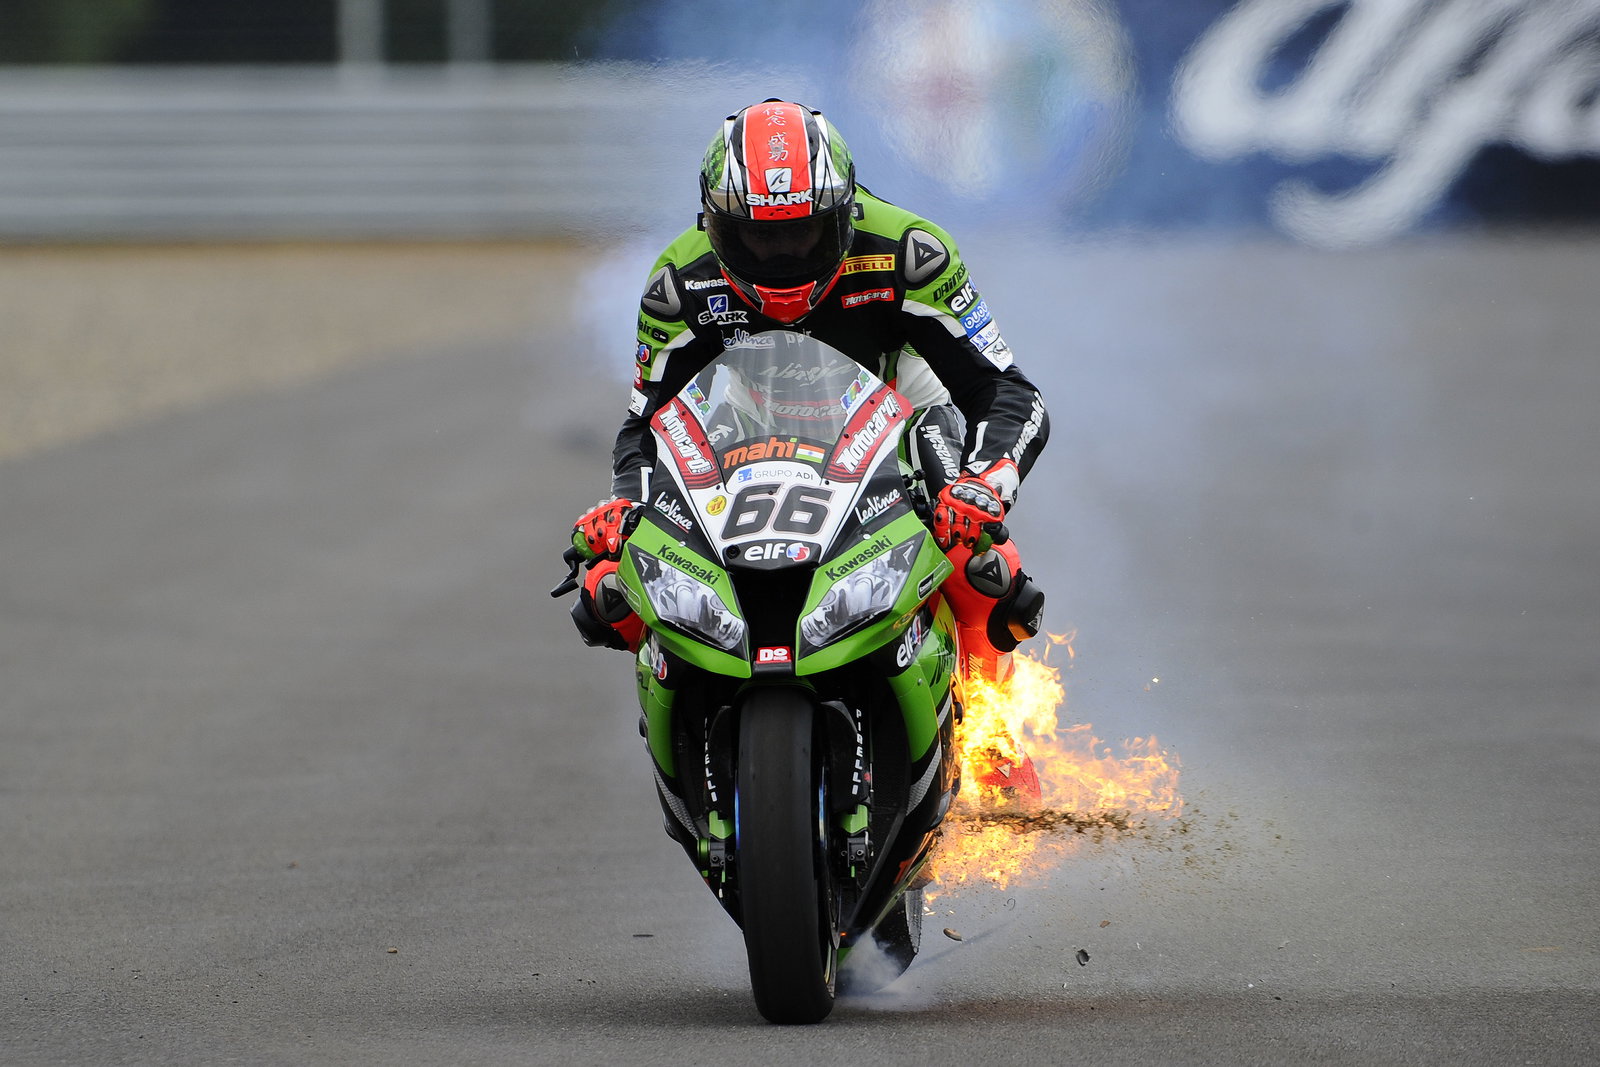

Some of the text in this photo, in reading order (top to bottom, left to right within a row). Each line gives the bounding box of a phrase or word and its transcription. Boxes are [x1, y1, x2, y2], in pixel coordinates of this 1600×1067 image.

[746, 188, 814, 207] SHARK
[684, 278, 730, 291] Kawasa
[841, 262, 892, 273] IRELLI
[951, 282, 974, 312] elf
[723, 329, 775, 350] eoVince
[763, 402, 847, 418] Motoca
[658, 401, 712, 472] Motocard
[836, 390, 898, 474] Motocard
[1003, 391, 1045, 467] awasaki
[723, 437, 798, 469] mahi
[754, 469, 792, 478] GRUPO
[795, 471, 814, 480] ADI
[653, 491, 694, 532] LeoVince
[720, 482, 836, 541] 66
[855, 488, 902, 525] LeoVince
[657, 544, 720, 585] Kawasaki
[744, 543, 787, 561] elf
[825, 535, 893, 582] Kawasaki
[897, 626, 914, 668] elf
[852, 708, 863, 796] PIRELLI
